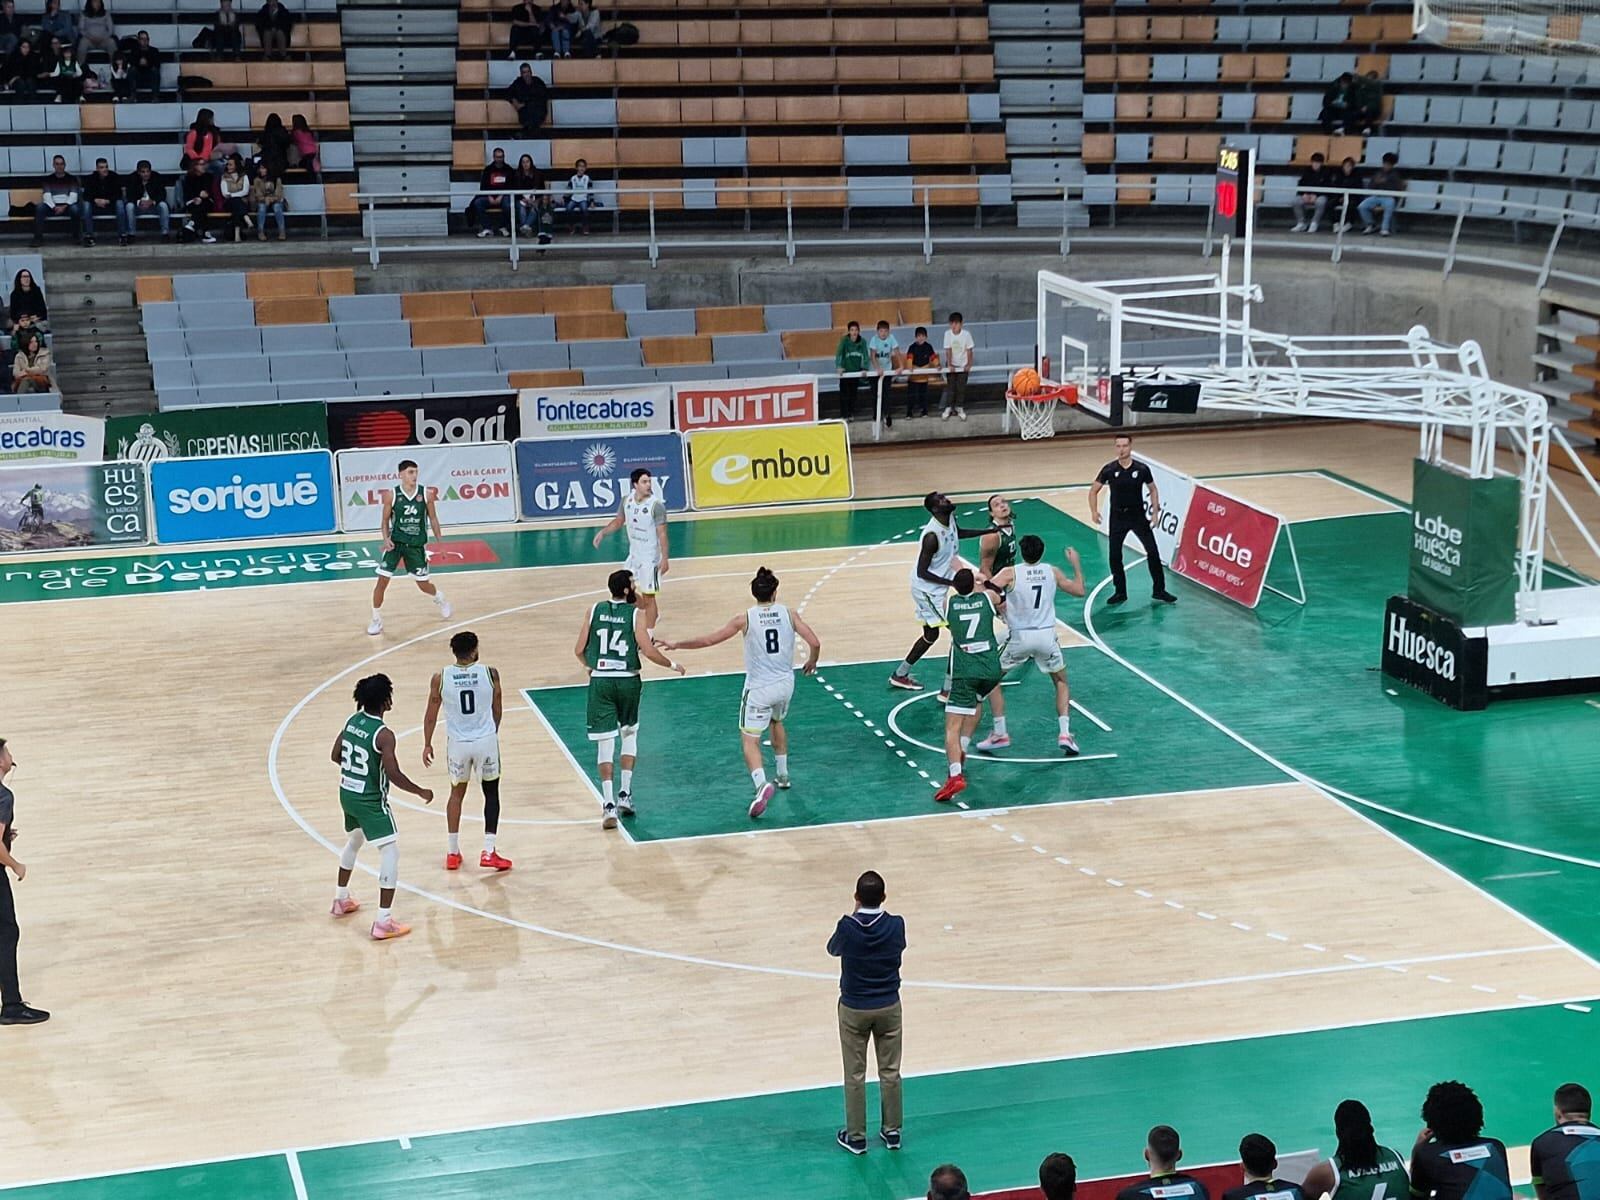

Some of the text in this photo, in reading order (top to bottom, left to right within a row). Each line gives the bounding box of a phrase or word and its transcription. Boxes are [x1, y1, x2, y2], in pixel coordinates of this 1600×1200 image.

[537, 396, 655, 421] Fontecabras
[685, 391, 806, 424] UNITIC
[415, 404, 507, 445] barri
[450, 470, 472, 478] CASH
[481, 467, 507, 477] CARRY
[404, 505, 418, 516] 24
[1414, 511, 1463, 546] Lobe
[133, 546, 372, 571] Municipal
[1197, 526, 1252, 568] Lobe
[1414, 532, 1461, 567] Huesca
[42, 559, 379, 590] de Deportes
[1031, 584, 1043, 610] 7
[959, 612, 981, 640] 7
[596, 628, 629, 657] 14
[765, 628, 780, 655] 8
[1387, 612, 1457, 682] Huesca
[459, 689, 476, 715] 0
[341, 739, 370, 777] 33
